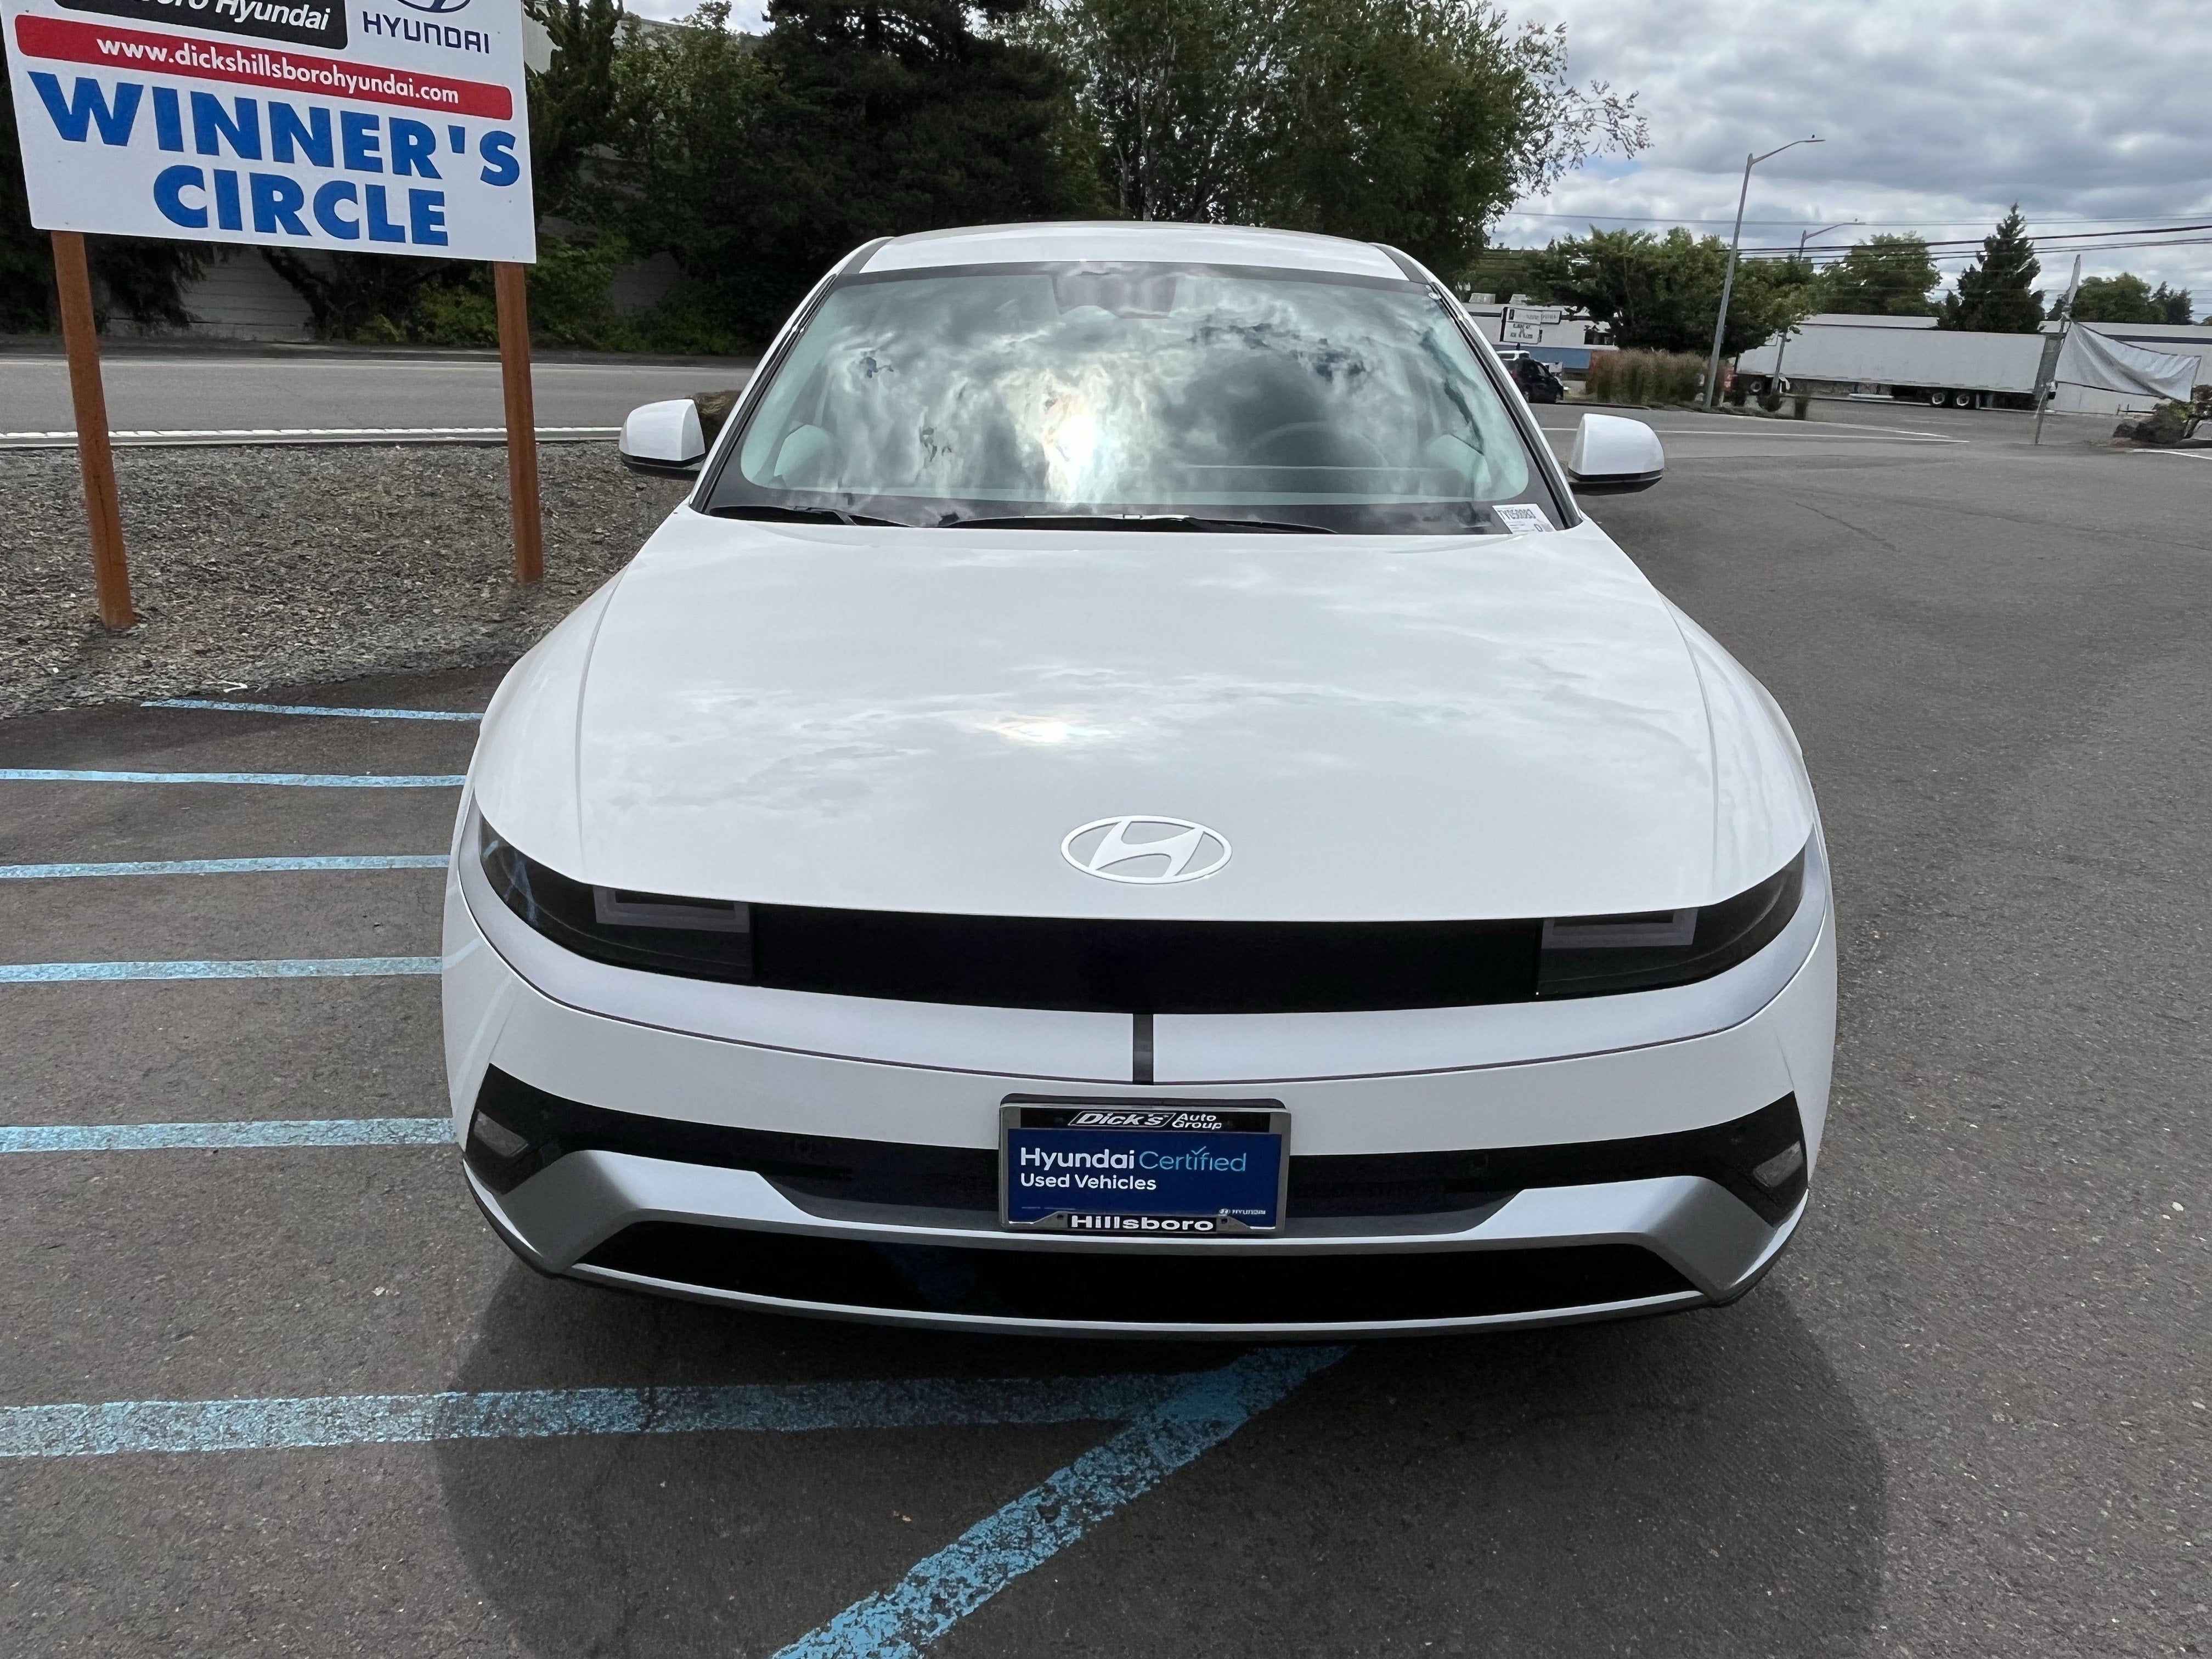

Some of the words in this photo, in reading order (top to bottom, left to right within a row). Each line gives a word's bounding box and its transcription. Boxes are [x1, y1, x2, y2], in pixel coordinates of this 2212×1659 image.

[215, 0, 331, 30] Hyundai
[362, 10, 489, 54] HYUNDAI
[97, 37, 459, 105] www.dickshillsborohyundai.com
[27, 71, 521, 187] WINNER'S
[153, 165, 449, 247] CIRCLE
[1171, 1120, 1222, 1130] Group
[1178, 1113, 1217, 1121] Auto
[1020, 1147, 1135, 1171] Hyundai
[1138, 1146, 1247, 1172] Certified
[1020, 1173, 1070, 1188] Used
[1074, 1174, 1157, 1190] Vehicles
[1071, 1215, 1214, 1231] Hillsboro
